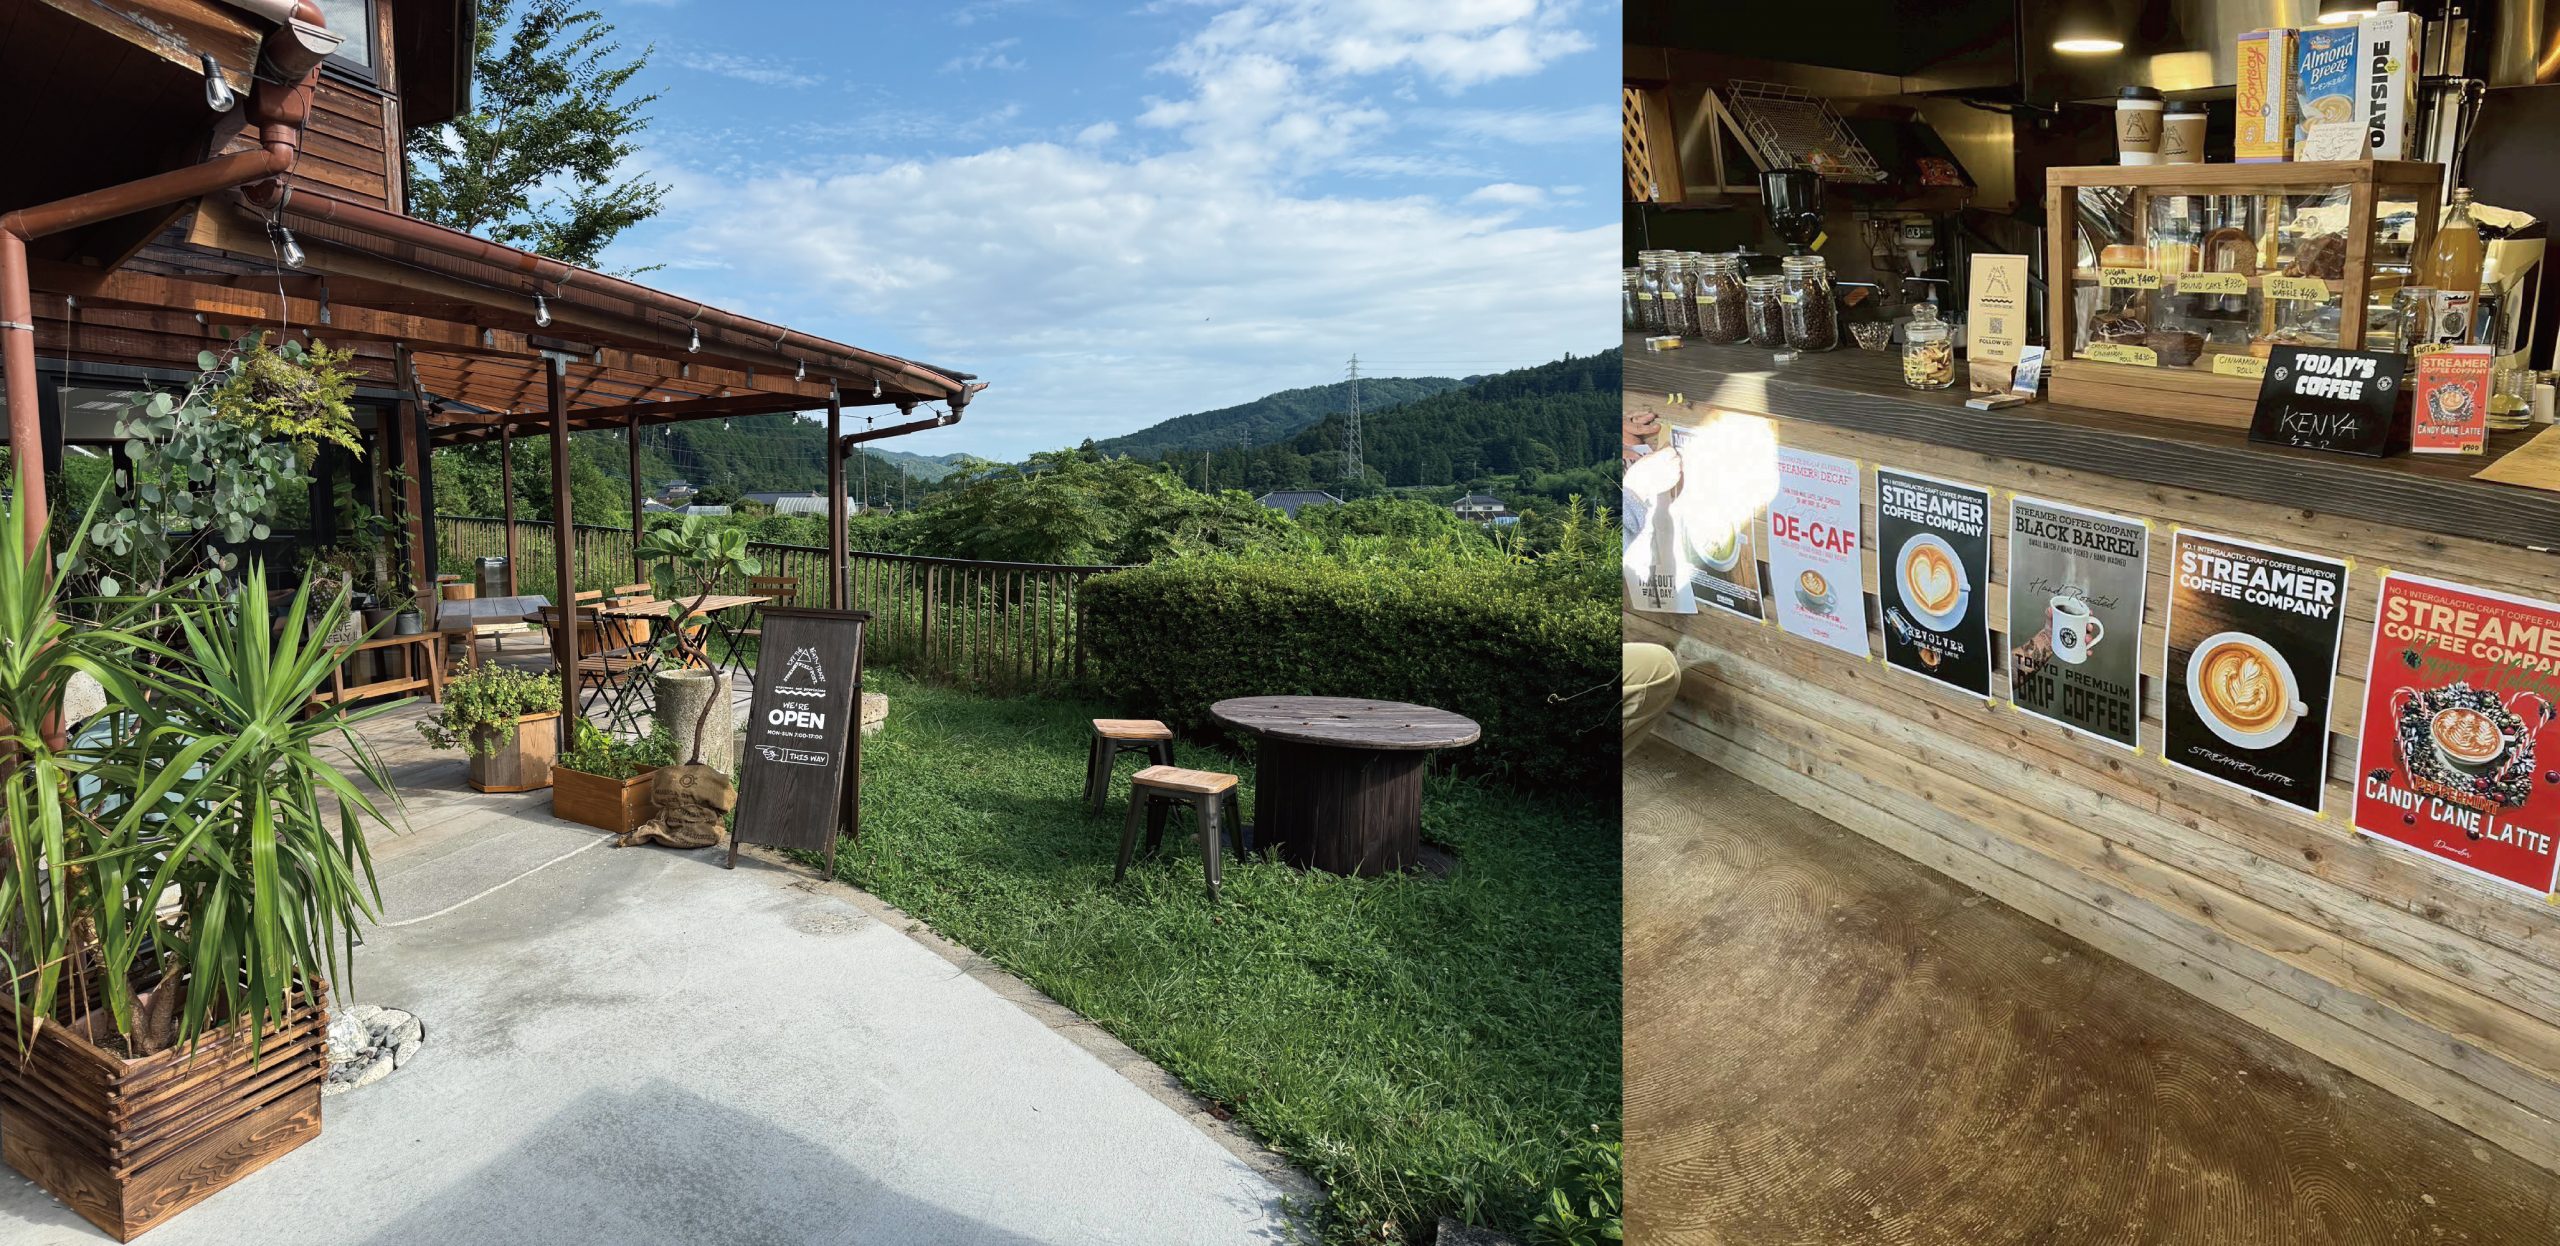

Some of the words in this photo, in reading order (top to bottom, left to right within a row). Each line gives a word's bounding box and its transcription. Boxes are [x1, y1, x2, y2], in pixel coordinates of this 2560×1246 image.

[2300, 36, 2354, 73] Almond
[2240, 47, 2266, 117] Bonsoy
[2310, 58, 2348, 85] Breeze
[2369, 41, 2390, 148] OATSIDE
[2104, 268, 2127, 277] SUGAR
[2181, 282, 2202, 290] POUND
[2205, 282, 2222, 290] CAKE
[2273, 280, 2294, 289] SPELT
[2220, 356, 2258, 366] CINNAMON
[2416, 345, 2432, 354] HOT
[2422, 358, 2488, 368] STREAMER
[2237, 366, 2253, 374] ROLL
[2295, 354, 2377, 378] TODAY'S
[2295, 376, 2364, 400] COFFEE
[2280, 405, 2359, 440] KENYA
[2418, 424, 2440, 434] CANDY
[2440, 425, 2458, 435] CANE
[2460, 426, 2480, 436] LATTE
[1882, 484, 1984, 525] STREAMER
[1892, 480, 1924, 492] INTERGALACTIC
[1925, 487, 1939, 495] CRAFT
[1940, 490, 1956, 498] COFFEE
[1957, 494, 1982, 504] PURVEYOR
[1773, 512, 1855, 554] DE-CAF
[1882, 504, 1924, 524] COFFEE
[1926, 514, 1983, 538] COMPANY
[2016, 506, 2057, 521] STREAMER
[2059, 515, 2092, 530] COFFEE
[2016, 516, 2069, 543] BLACK
[2072, 528, 2139, 558] BARREL
[2029, 538, 2042, 547] SMALL
[2043, 540, 2056, 551] BATCH
[2061, 544, 2072, 554] HAND
[2094, 552, 2106, 563] HAND
[2108, 556, 2126, 568] WASHED
[2181, 551, 2336, 605] STREAMER
[2197, 545, 2246, 562] INTERGALACTIC
[2246, 554, 2268, 566] CRAFT
[2269, 560, 2296, 572] COFFEE
[2297, 565, 2337, 580] PURVEYOR
[2030, 578, 2064, 596] Hand
[2064, 586, 2119, 610] Roasted
[2180, 574, 2242, 600] COFFEE
[2244, 588, 2334, 620] COMPANY
[2410, 590, 2476, 611] INTERGALACTIC
[2476, 602, 2505, 616] CRAFT
[2507, 611, 2544, 624] COFFEE
[1908, 628, 1965, 653] REVOLVER
[2384, 622, 2468, 654] COFFEE
[2386, 596, 2560, 658] STREAME
[2015, 654, 2058, 676] TOKYO
[2066, 669, 2130, 700] PREMIUM
[783, 702, 810, 710] WE'RE
[2018, 668, 2054, 709] DRIP
[2063, 684, 2130, 736] COFFEE
[767, 730, 793, 738] MON-SUN
[794, 732, 823, 740] 7:00-17:00
[768, 709, 826, 730] OPEN
[2414, 776, 2500, 815] PEPPERMINT
[2366, 776, 2426, 814] CANDY
[2430, 798, 2482, 833] CANE
[2486, 815, 2551, 855] LATTE
